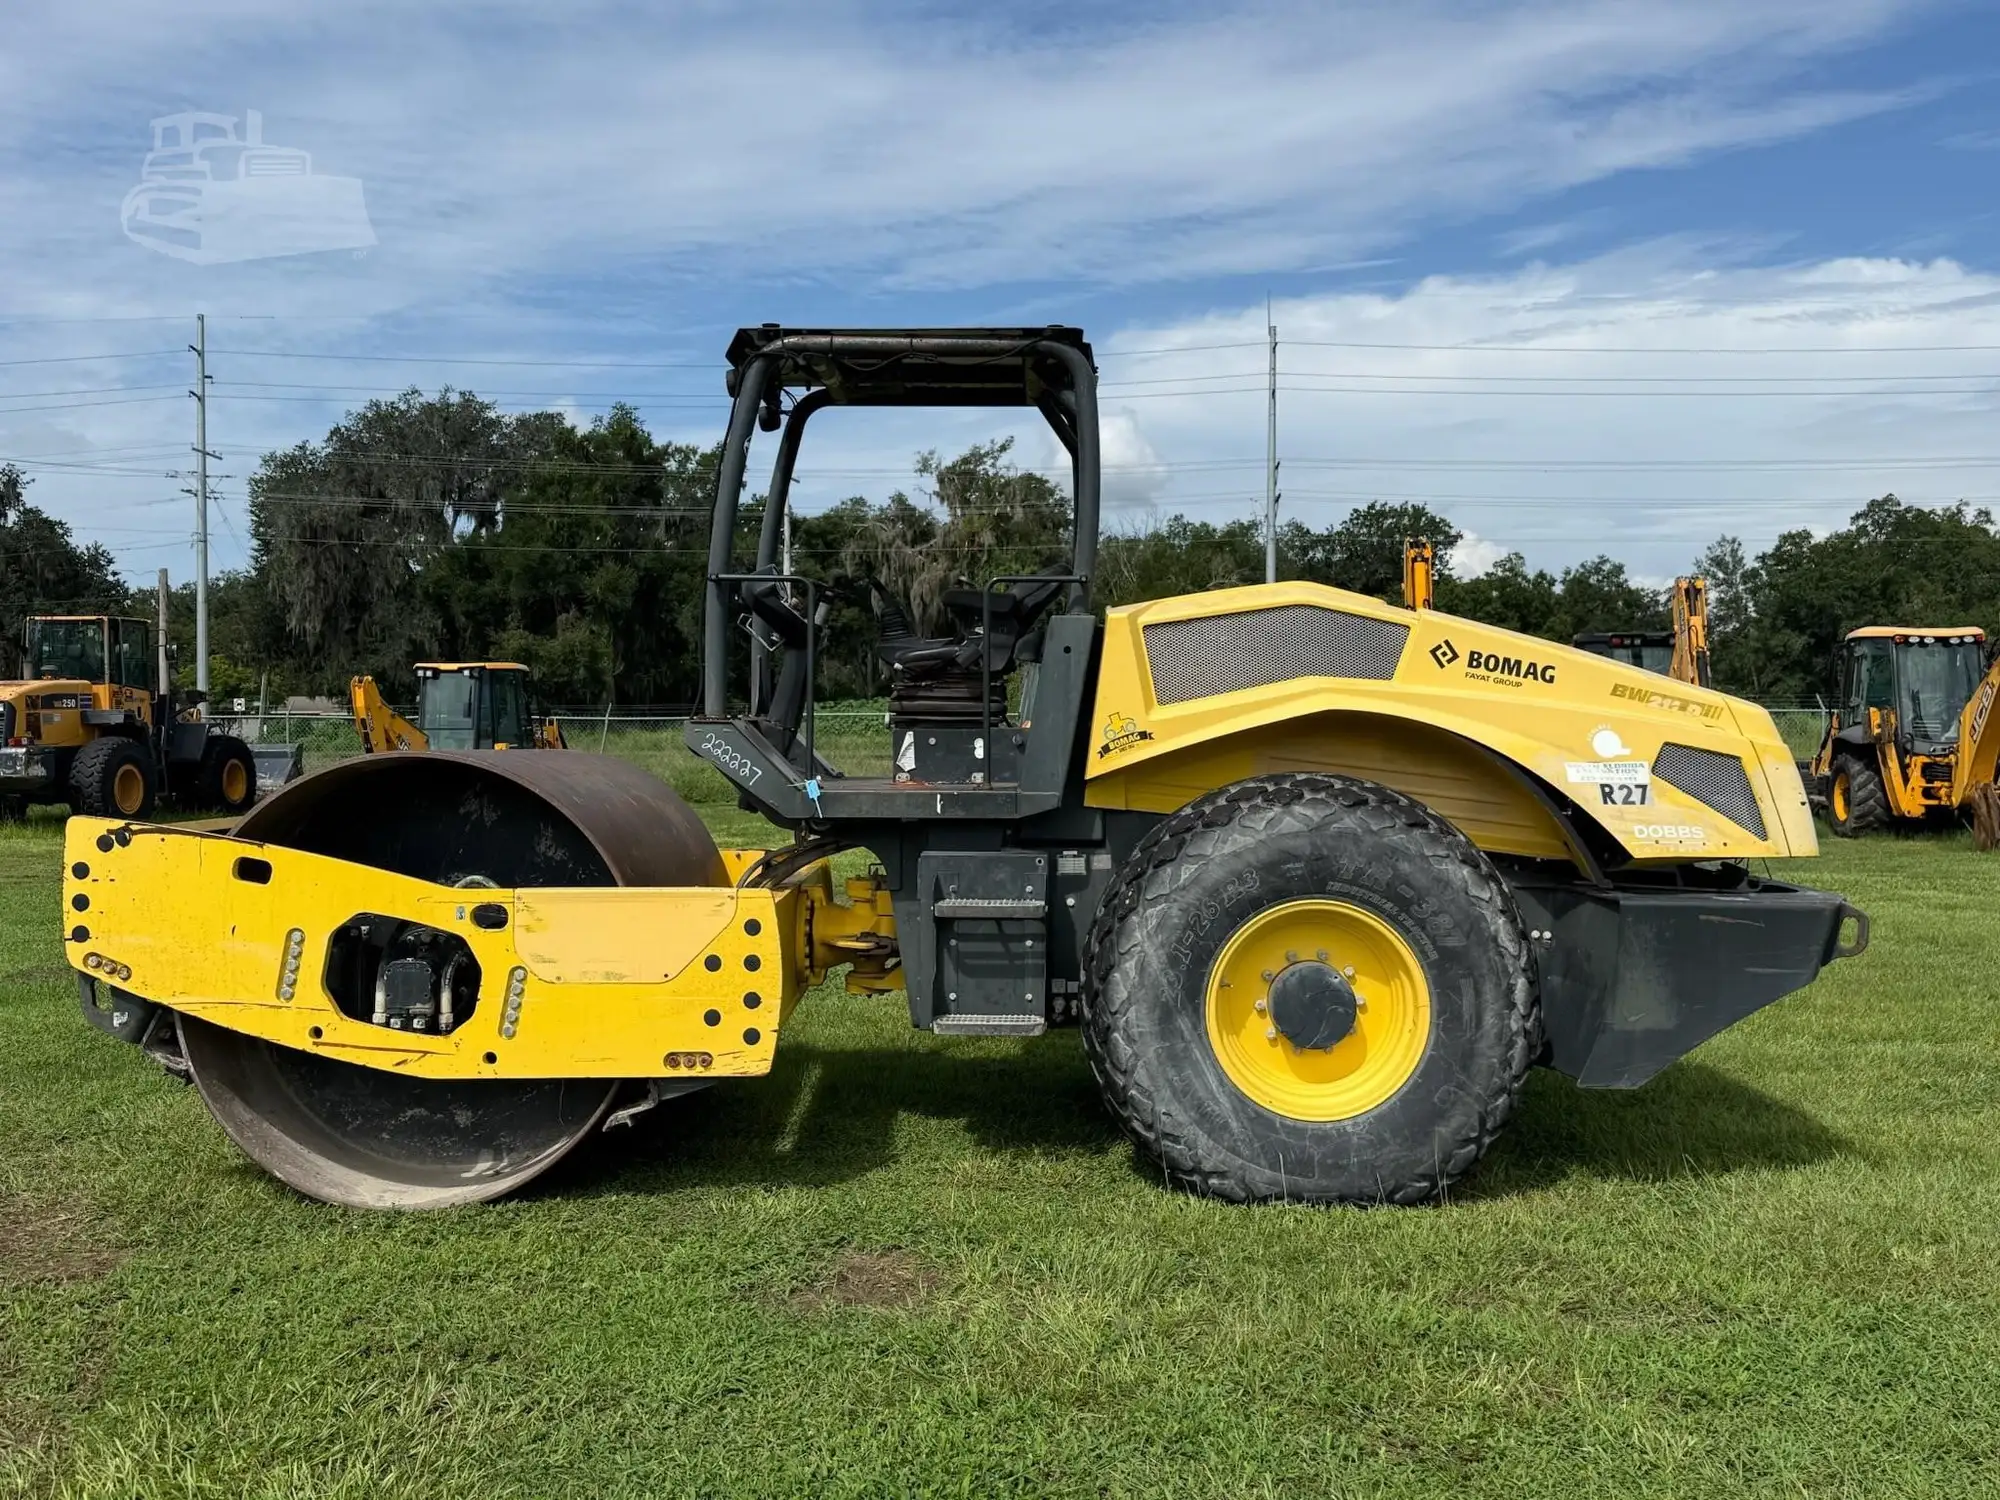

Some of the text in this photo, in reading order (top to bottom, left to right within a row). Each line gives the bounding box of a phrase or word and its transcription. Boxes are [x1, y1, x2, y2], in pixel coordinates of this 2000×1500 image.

[1466, 650, 1556, 684] BOMAG
[1465, 671, 1523, 688] FAYAT GROUP
[62, 699, 76, 708] 250
[1969, 683, 1993, 743] JCB
[1108, 732, 1141, 750] BOMAG
[701, 732, 763, 786] 222227
[1599, 783, 1648, 805] R27
[1633, 825, 1705, 839] DOBBS
